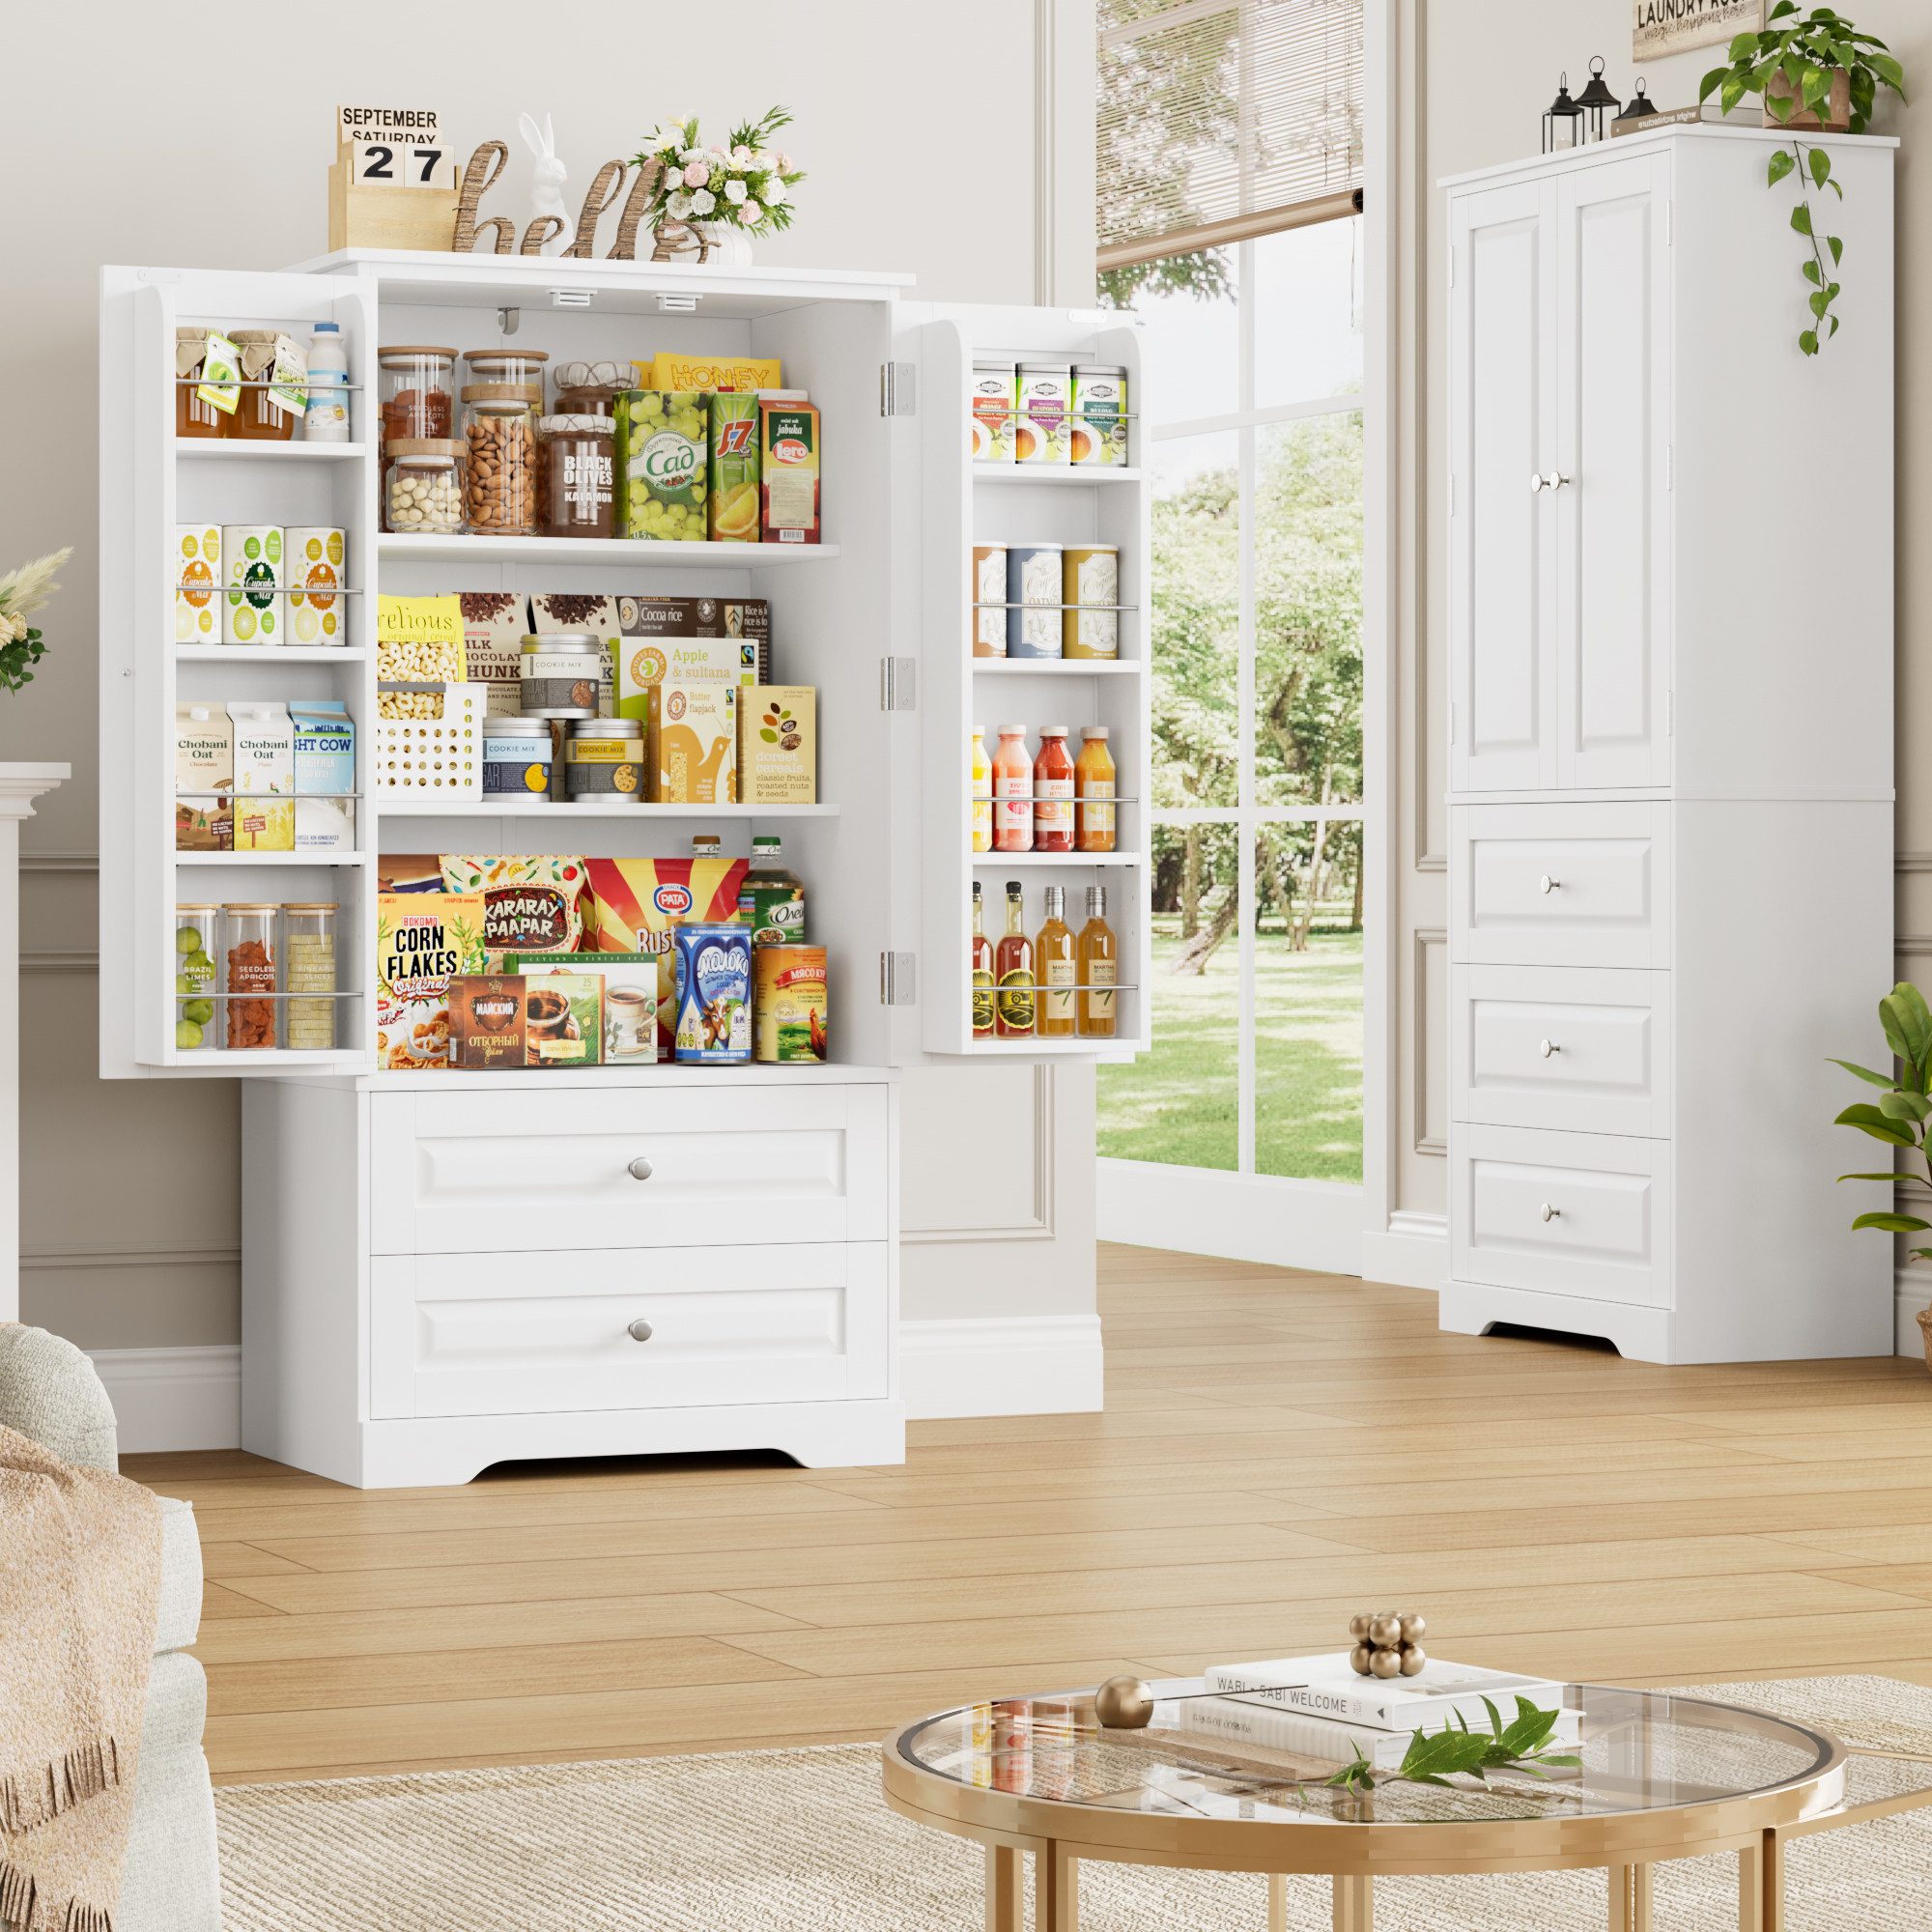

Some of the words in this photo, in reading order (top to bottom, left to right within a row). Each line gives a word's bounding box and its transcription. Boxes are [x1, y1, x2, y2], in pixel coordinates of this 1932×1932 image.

[1676, 13, 1721, 32] happens
[1723, 3, 1747, 19] here
[343, 107, 437, 128] SEPTEMBER
[353, 130, 437, 144] SATURDAY
[452, 139, 722, 264] hello
[670, 364, 769, 389] HONEY
[776, 424, 803, 437] jabuka
[564, 455, 612, 470] BLACK
[646, 445, 694, 476] Сад
[563, 469, 613, 485] OLIVES
[564, 491, 612, 503] KALAMON
[640, 607, 667, 621] Cocoa
[668, 608, 683, 621] rice
[745, 605, 757, 615] Rice
[466, 639, 493, 650] ILK
[467, 653, 521, 662] OCOLAT
[672, 648, 709, 664] Apple
[467, 665, 521, 678] HUNK
[672, 665, 682, 677] &
[685, 666, 730, 678] sultana
[178, 739, 227, 749] Chobani
[240, 740, 288, 749] Chobani
[295, 739, 317, 751] HT
[320, 739, 352, 752] COW
[191, 750, 213, 759] Oat
[253, 750, 274, 759] Oat
[483, 764, 499, 787] GAR
[786, 774, 812, 782] fruits,
[661, 895, 685, 906] PATA
[484, 898, 559, 921] KARARAY
[403, 917, 438, 927] BOKOMO
[486, 918, 554, 939] PAAPAR
[395, 925, 444, 952] CORN
[636, 924, 676, 955] Rust
[387, 951, 457, 980] FLAKES
[790, 968, 815, 980] МЯСО
[392, 972, 449, 996] Original
[476, 1002, 514, 1015] МАЙСКИЙ
[469, 1034, 520, 1046] ОТБОРНЫЙ
[1217, 1677, 1246, 1694] WABI
[1259, 1685, 1286, 1703] SABI
[1291, 1690, 1348, 1714] WELCOME
